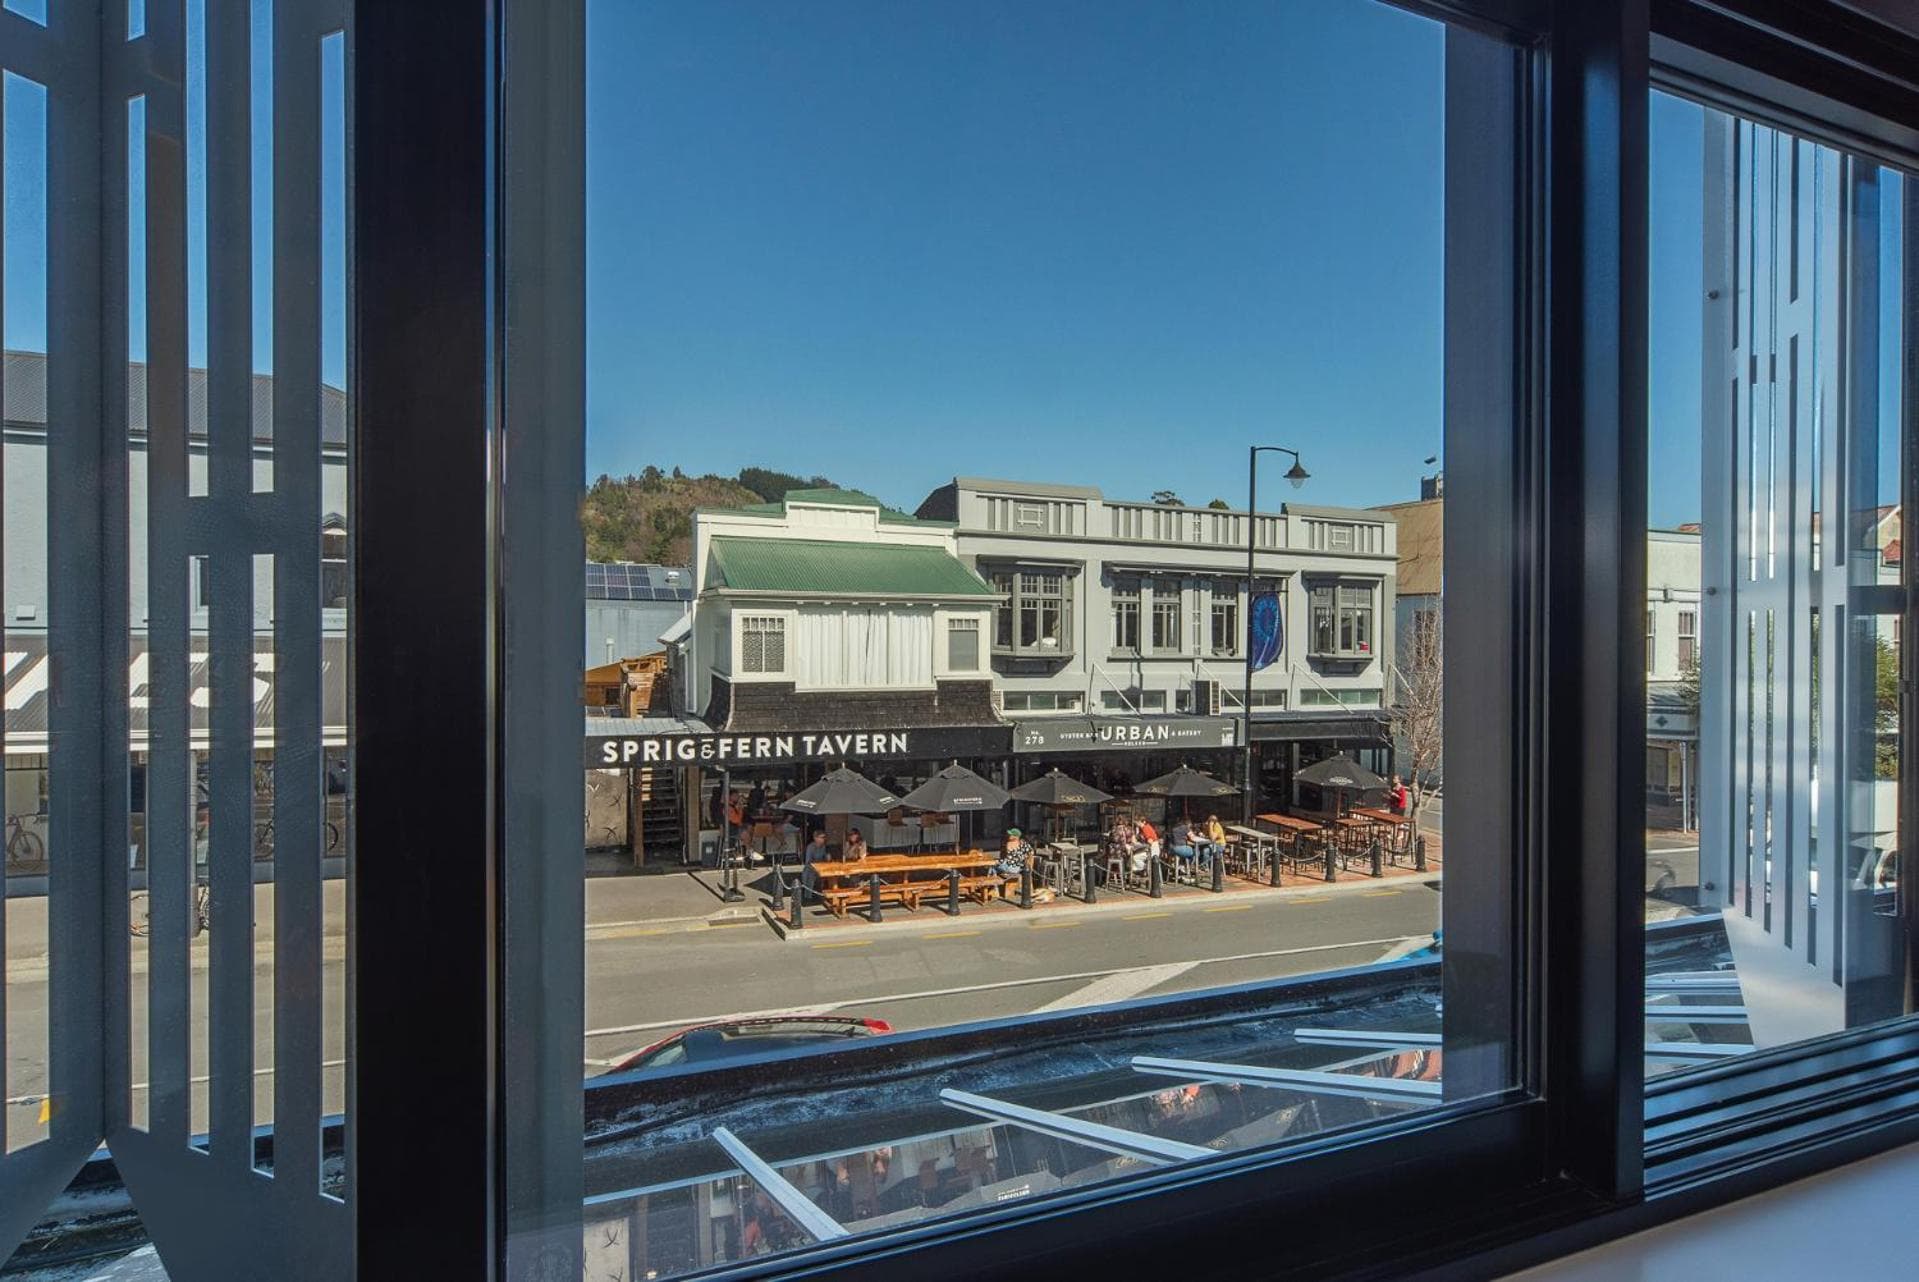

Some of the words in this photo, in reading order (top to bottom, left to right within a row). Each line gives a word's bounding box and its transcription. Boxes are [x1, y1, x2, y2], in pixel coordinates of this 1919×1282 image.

[1025, 735, 1045, 745] 278
[1101, 725, 1169, 741] URBAN
[602, 739, 697, 763] SPRIG
[700, 738, 716, 760] &
[718, 736, 794, 759] FERN
[802, 733, 908, 756] TAVERN
